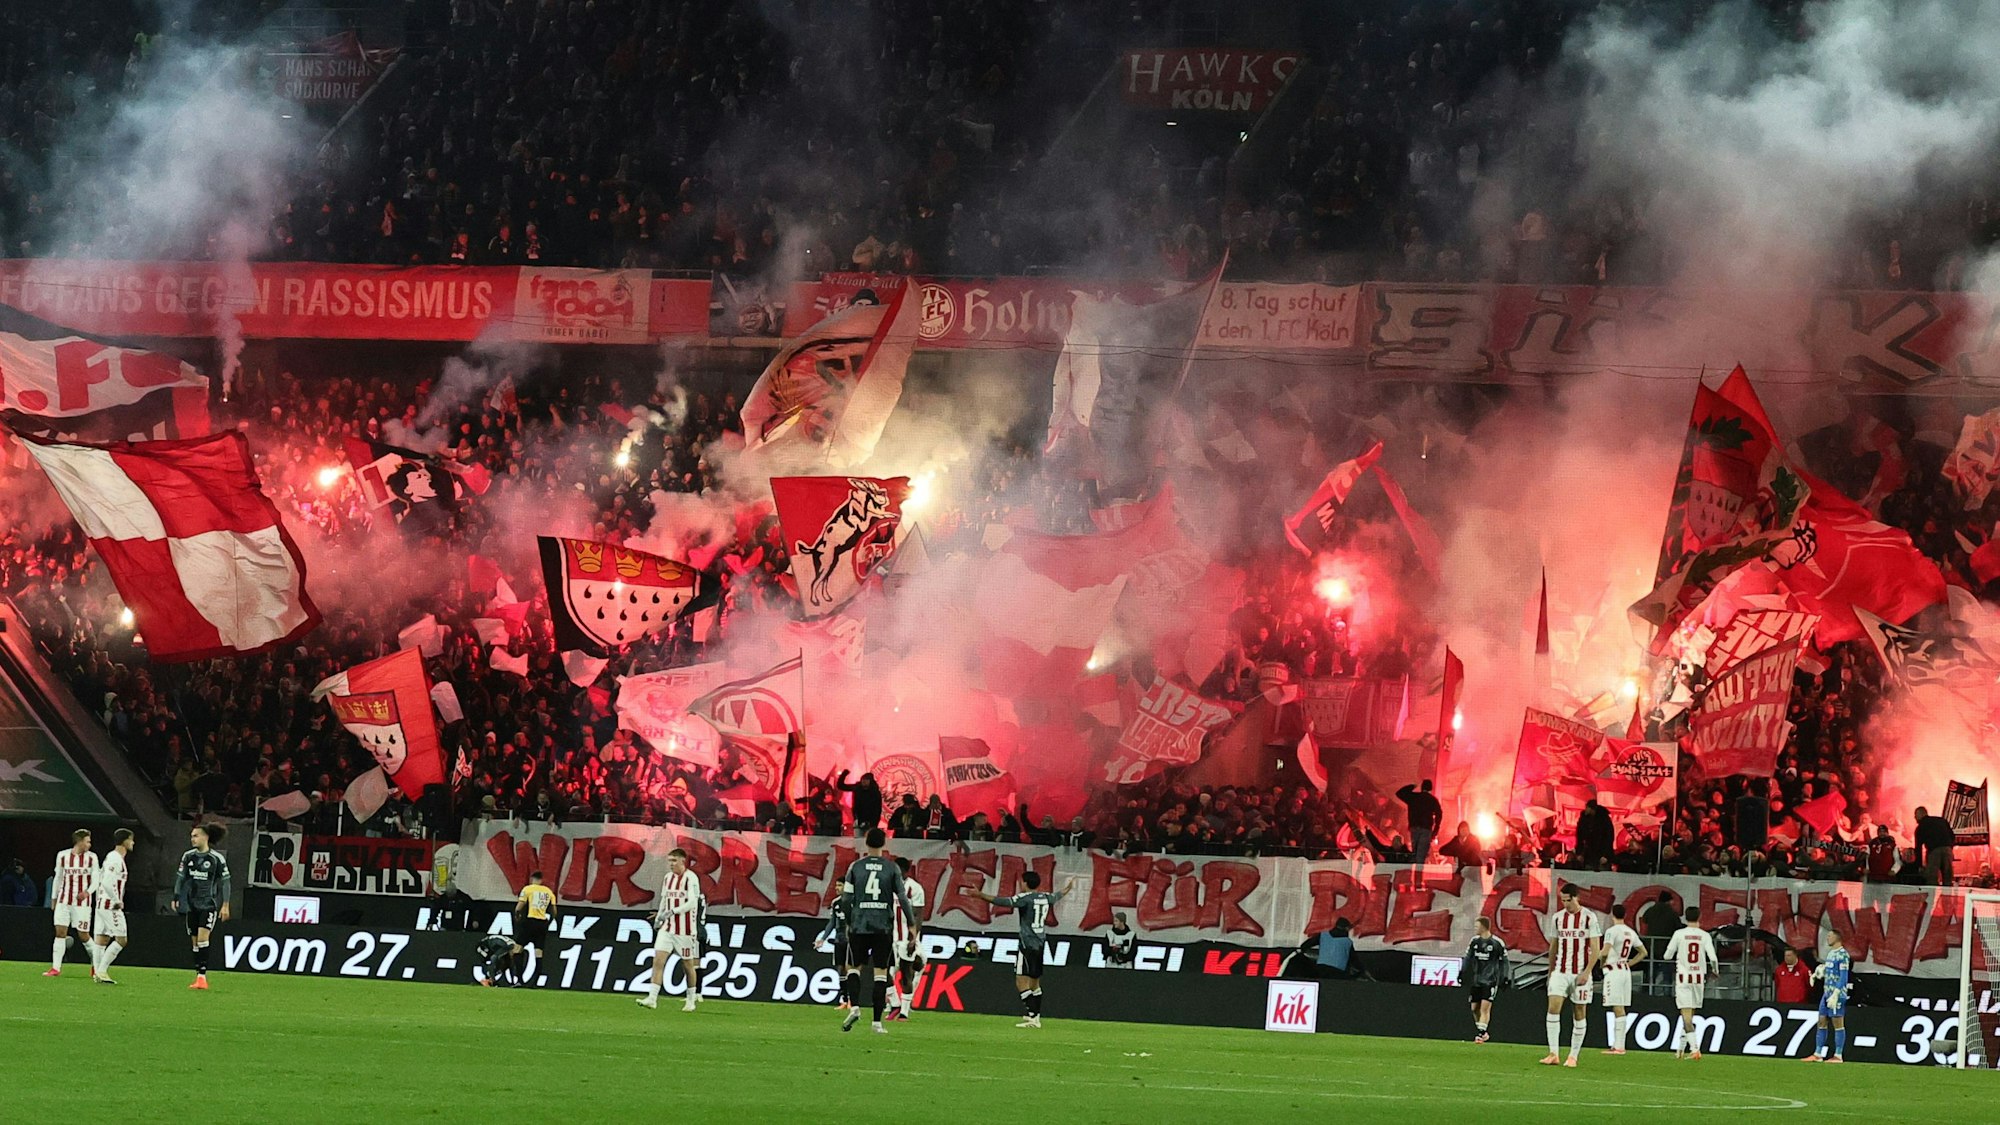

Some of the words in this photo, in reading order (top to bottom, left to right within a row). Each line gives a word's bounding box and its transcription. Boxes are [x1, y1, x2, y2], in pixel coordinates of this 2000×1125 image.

[285, 59, 323, 77] HANS
[328, 59, 374, 77] SCHA
[1171, 83, 1253, 111] KÖLN
[155, 275, 270, 314] GEGN
[282, 278, 493, 320] RASSISMUS
[1221, 287, 1238, 311] 8.
[1244, 287, 1280, 316] Tag
[1289, 288, 1347, 312] schuf
[1218, 317, 1252, 338] den
[1306, 314, 1349, 341] Köln
[486, 830, 656, 908] WIR
[1079, 849, 1265, 938] FÜR
[1304, 869, 1466, 946] DIE
[864, 871, 882, 901] 4
[77, 920, 89, 931] 28
[224, 935, 327, 973] vom
[340, 931, 415, 979] 27.
[436, 958, 458, 969] -
[1620, 938, 1632, 959] 6
[1687, 942, 1700, 964] 8
[1272, 992, 1311, 1026] kik
[1578, 989, 1588, 1001] 16
